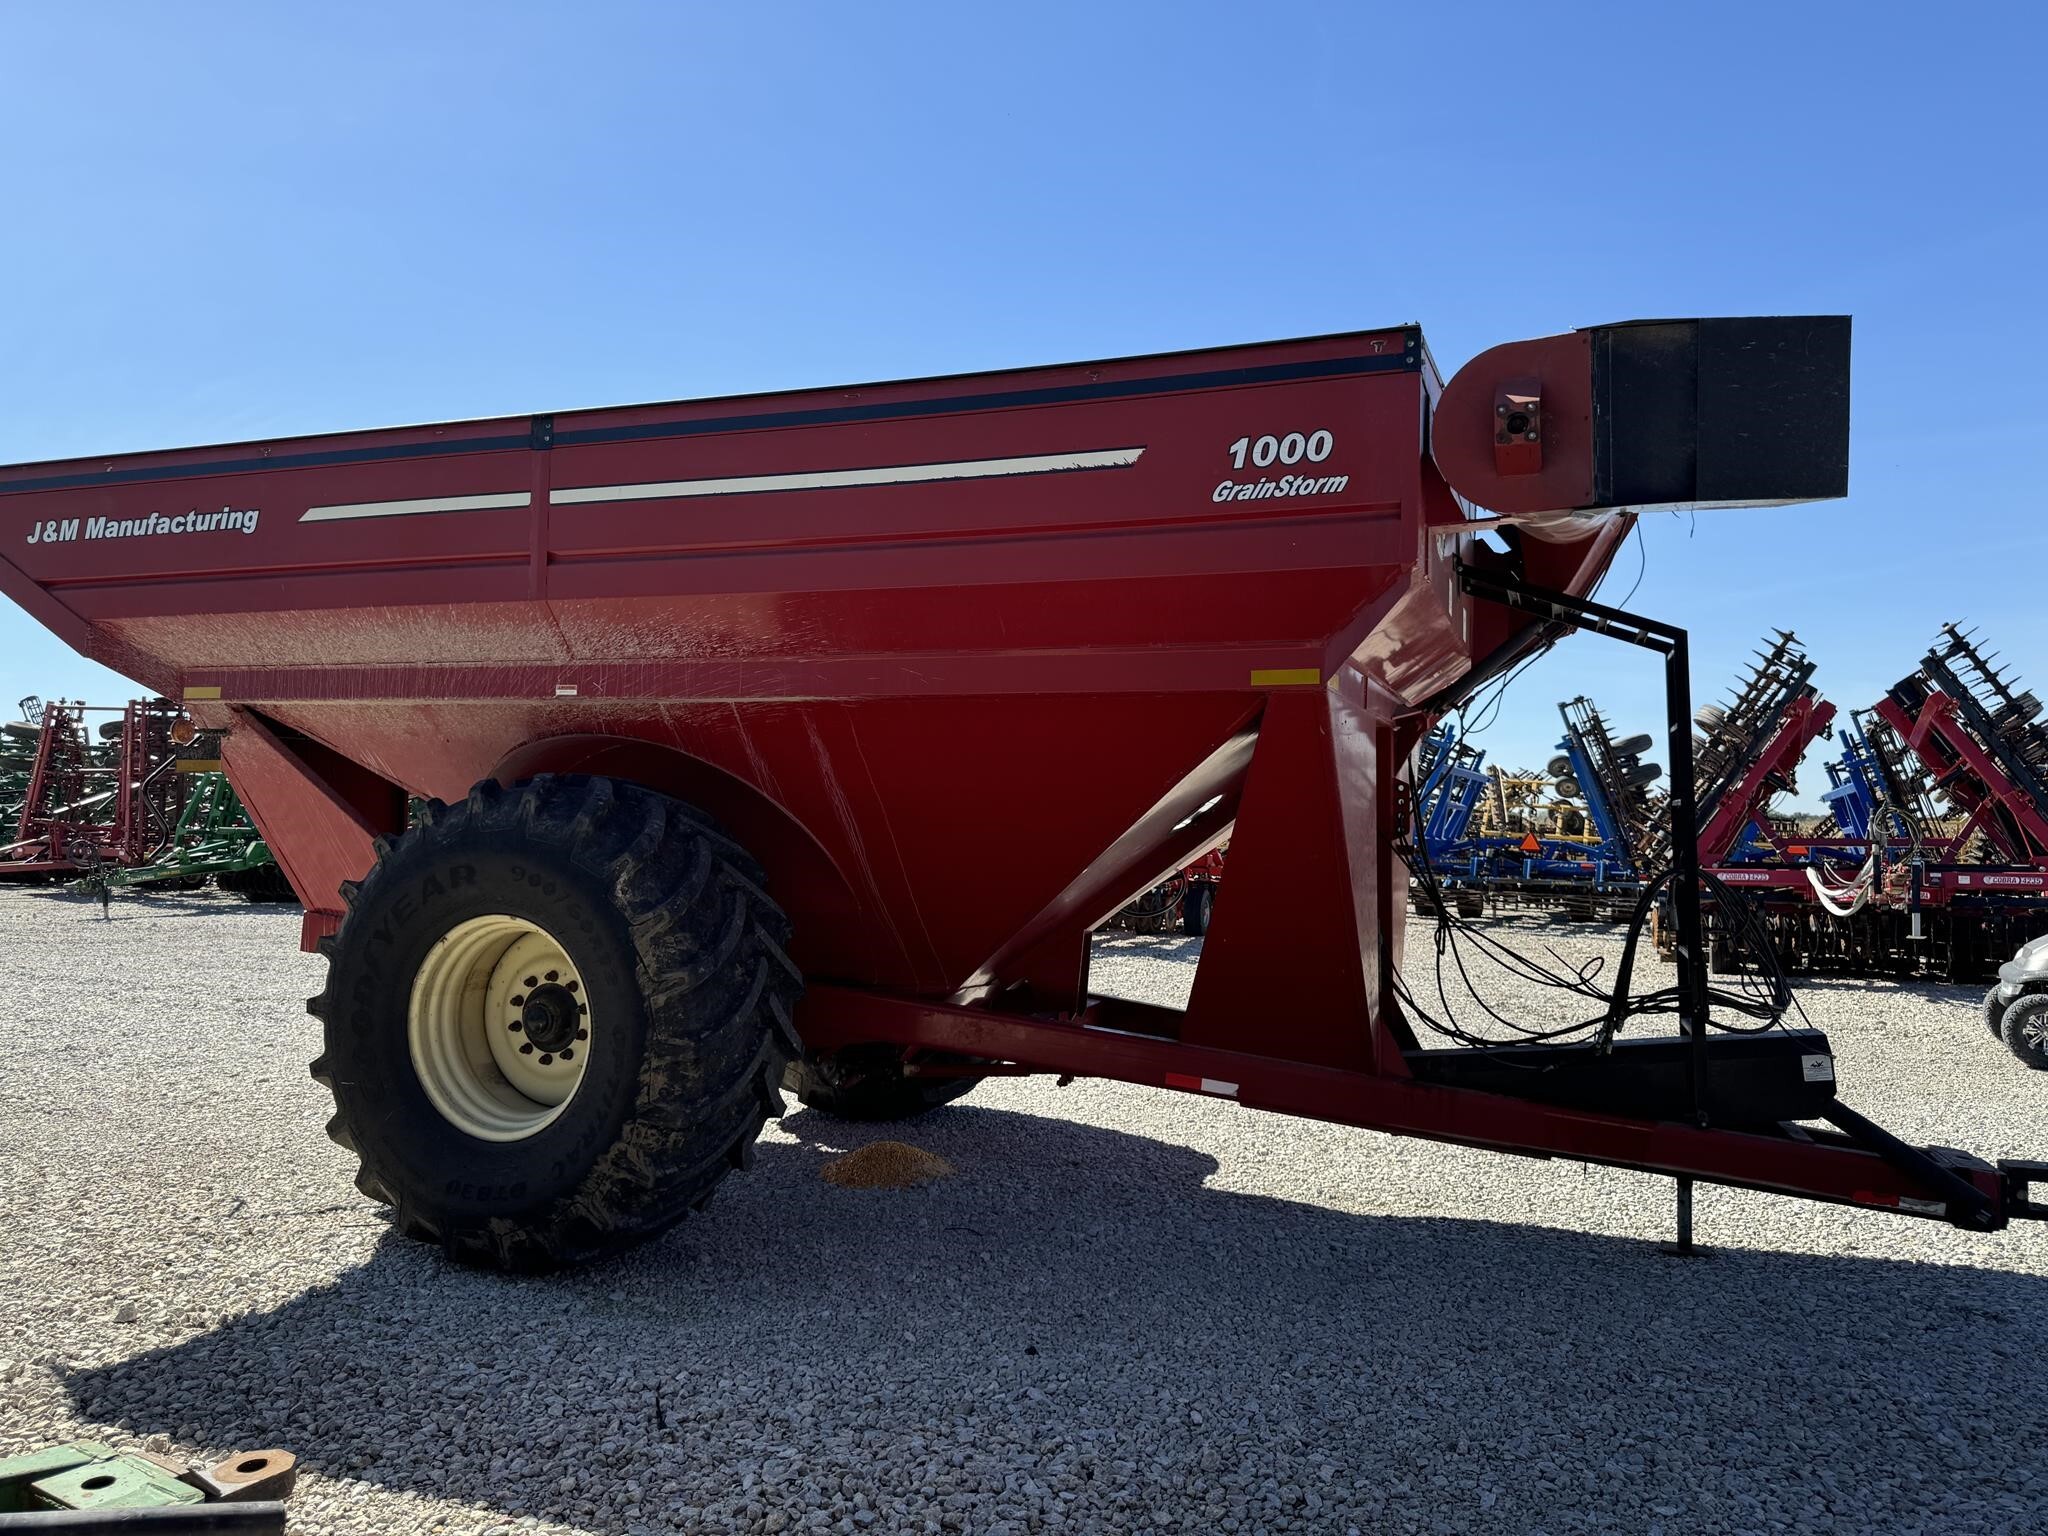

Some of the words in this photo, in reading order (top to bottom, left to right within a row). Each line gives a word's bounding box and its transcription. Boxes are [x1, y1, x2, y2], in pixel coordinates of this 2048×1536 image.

[1228, 428, 1334, 469] 1000
[1211, 473, 1349, 502] GrainStorm
[26, 517, 80, 544] J&M
[84, 506, 260, 540] Manufacturing
